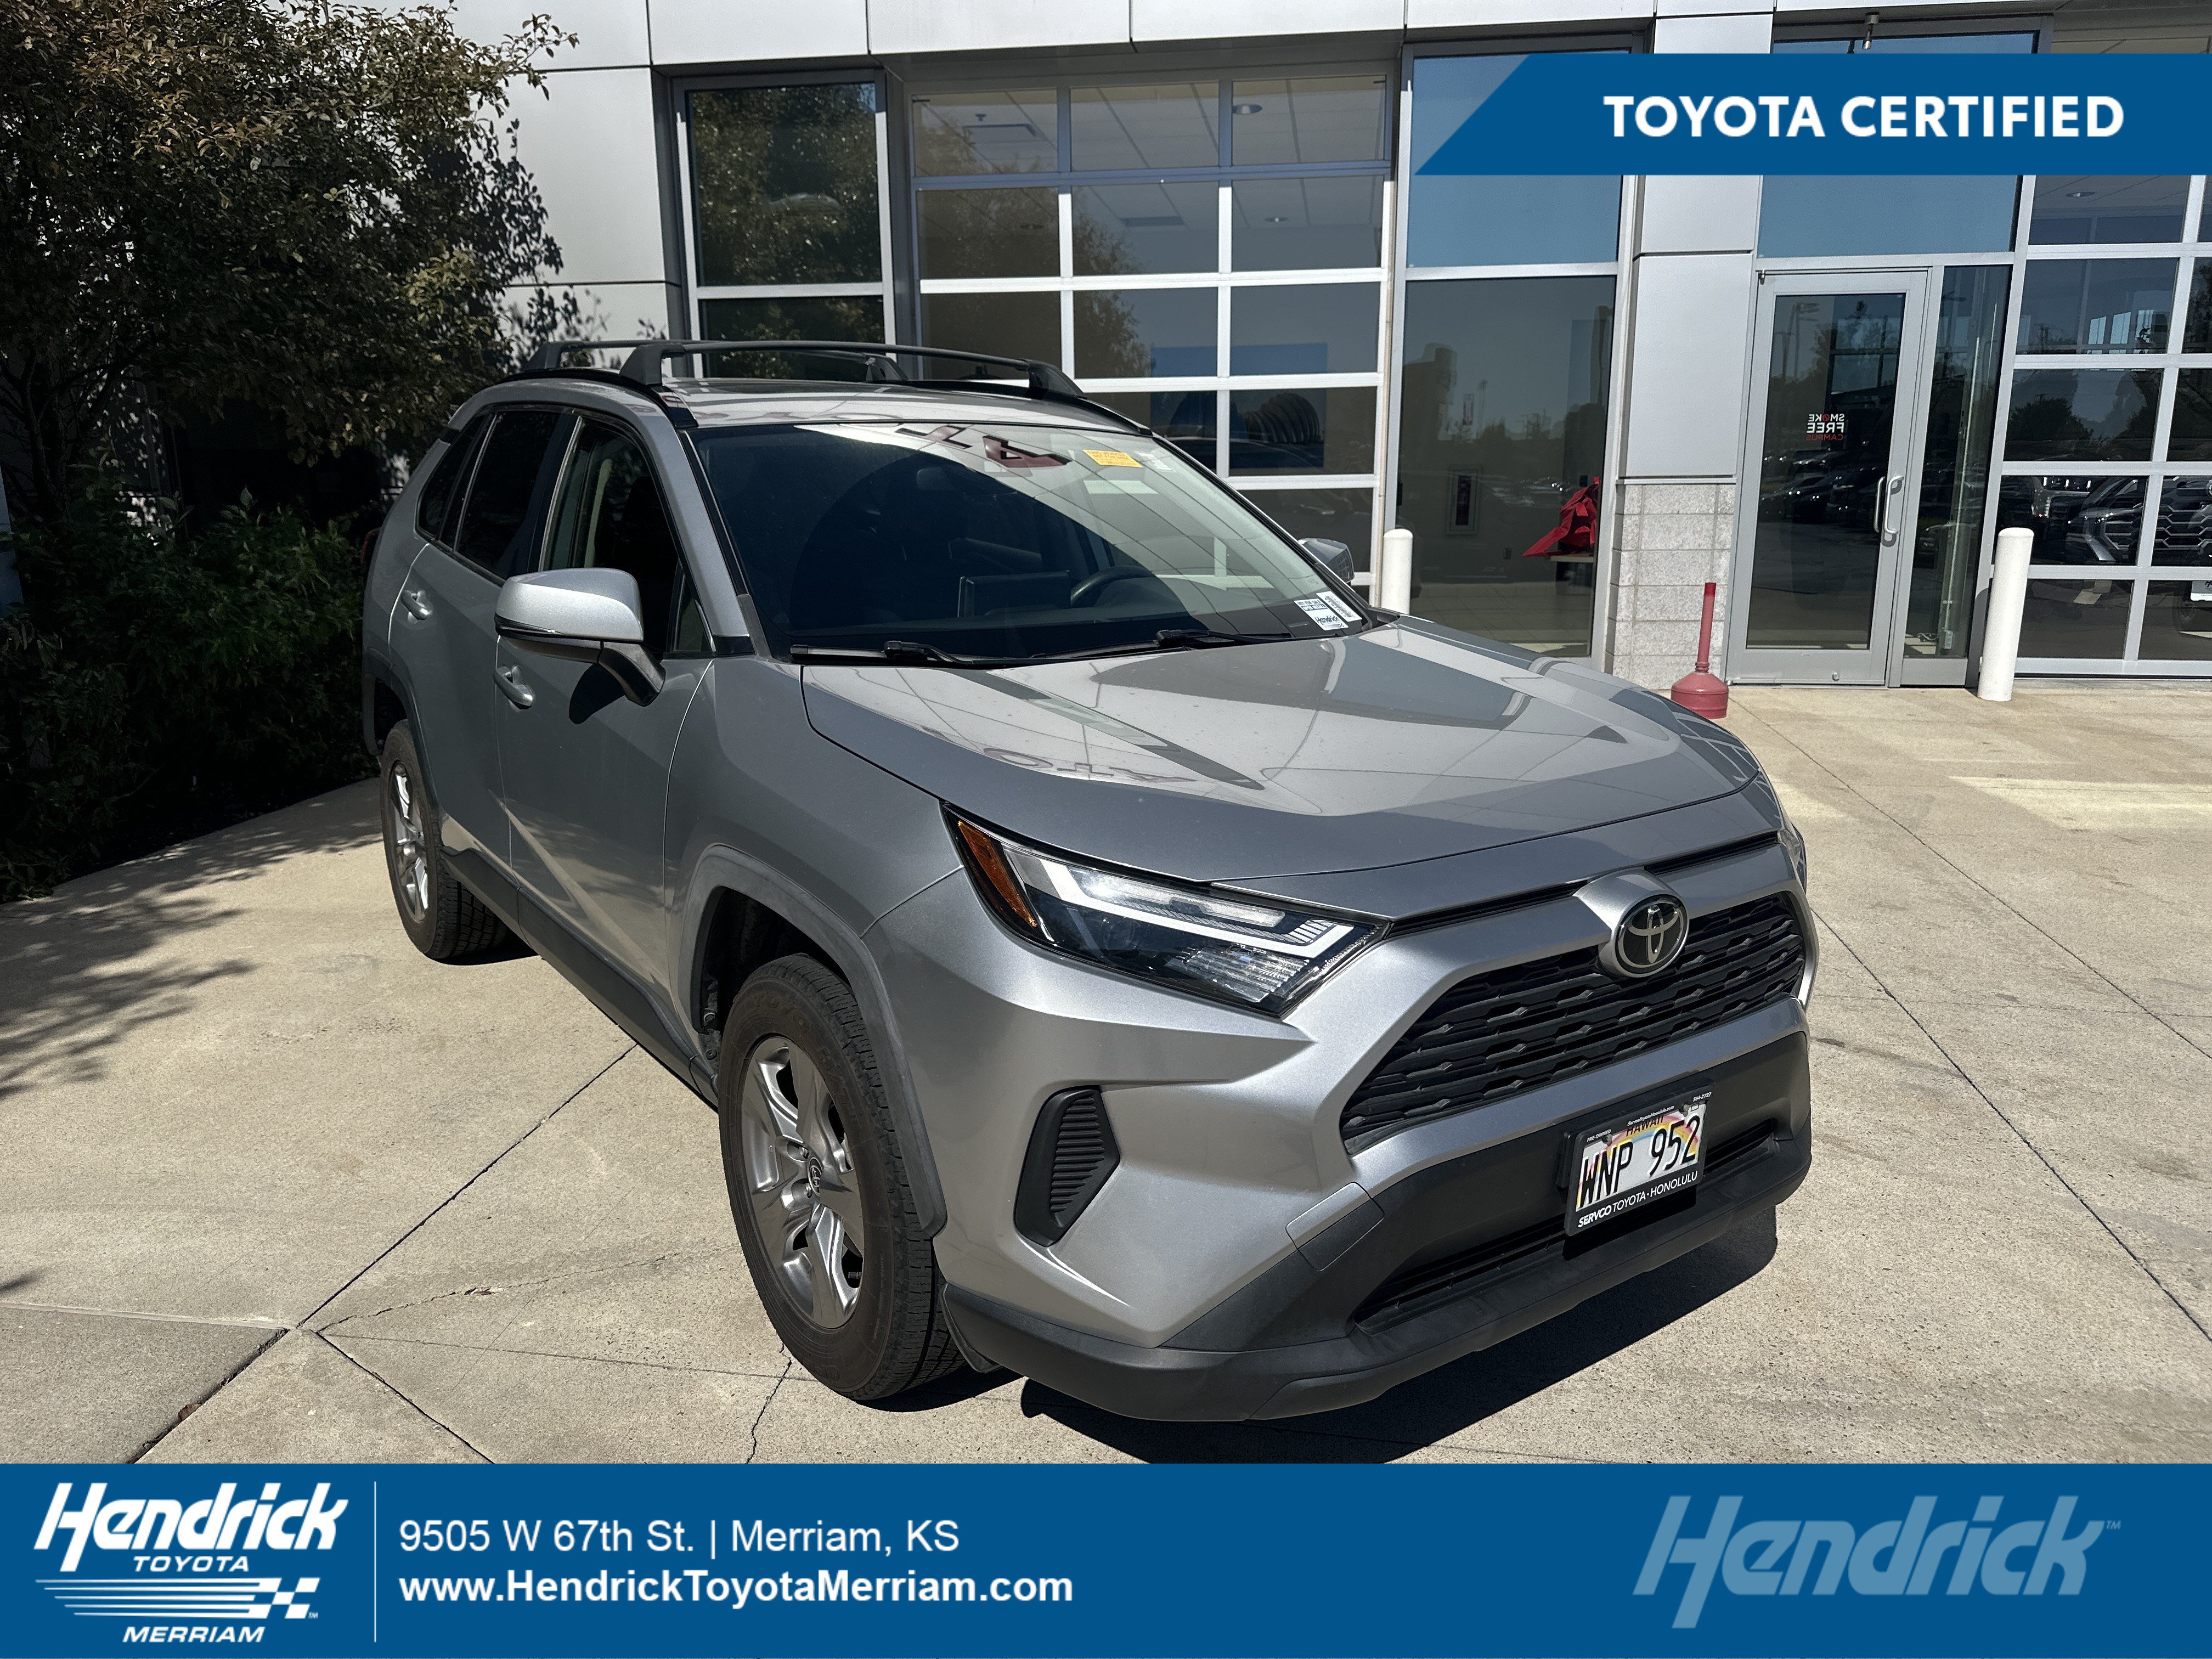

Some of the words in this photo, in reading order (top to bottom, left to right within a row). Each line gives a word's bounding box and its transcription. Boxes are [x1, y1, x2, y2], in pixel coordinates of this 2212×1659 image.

[1314, 615, 1339, 625] Hendrick
[1626, 1115, 1663, 1137] HAWAII
[1577, 1141, 1633, 1209] WNP
[1649, 1115, 1700, 1177] 952
[1578, 1205, 1612, 1228] SERVCO
[1612, 1191, 1646, 1212] TOYOTA
[1650, 1171, 1698, 1197] HONOLULU
